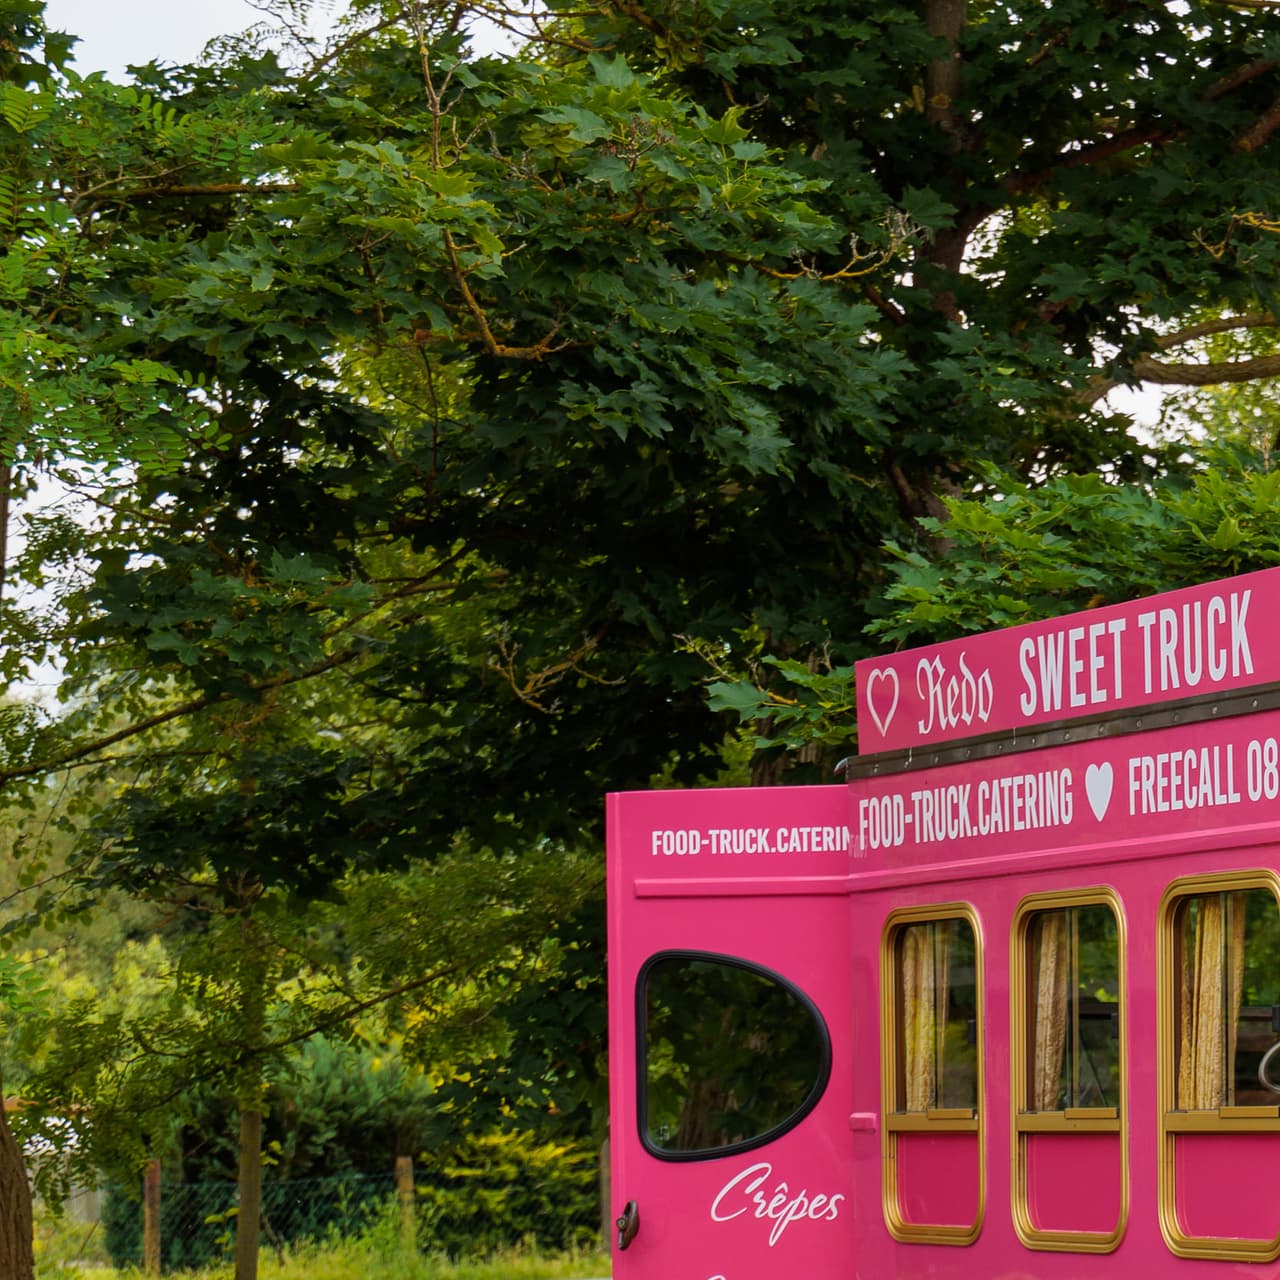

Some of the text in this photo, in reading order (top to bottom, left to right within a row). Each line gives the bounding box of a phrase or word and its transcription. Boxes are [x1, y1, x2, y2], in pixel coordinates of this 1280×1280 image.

[916, 590, 1254, 735] Redo SWEET TRUCK
[859, 767, 1073, 851] FOOD-TRUCK.CATERING
[1129, 744, 1240, 815] FREECALL
[710, 1162, 845, 1247] Crêpes
